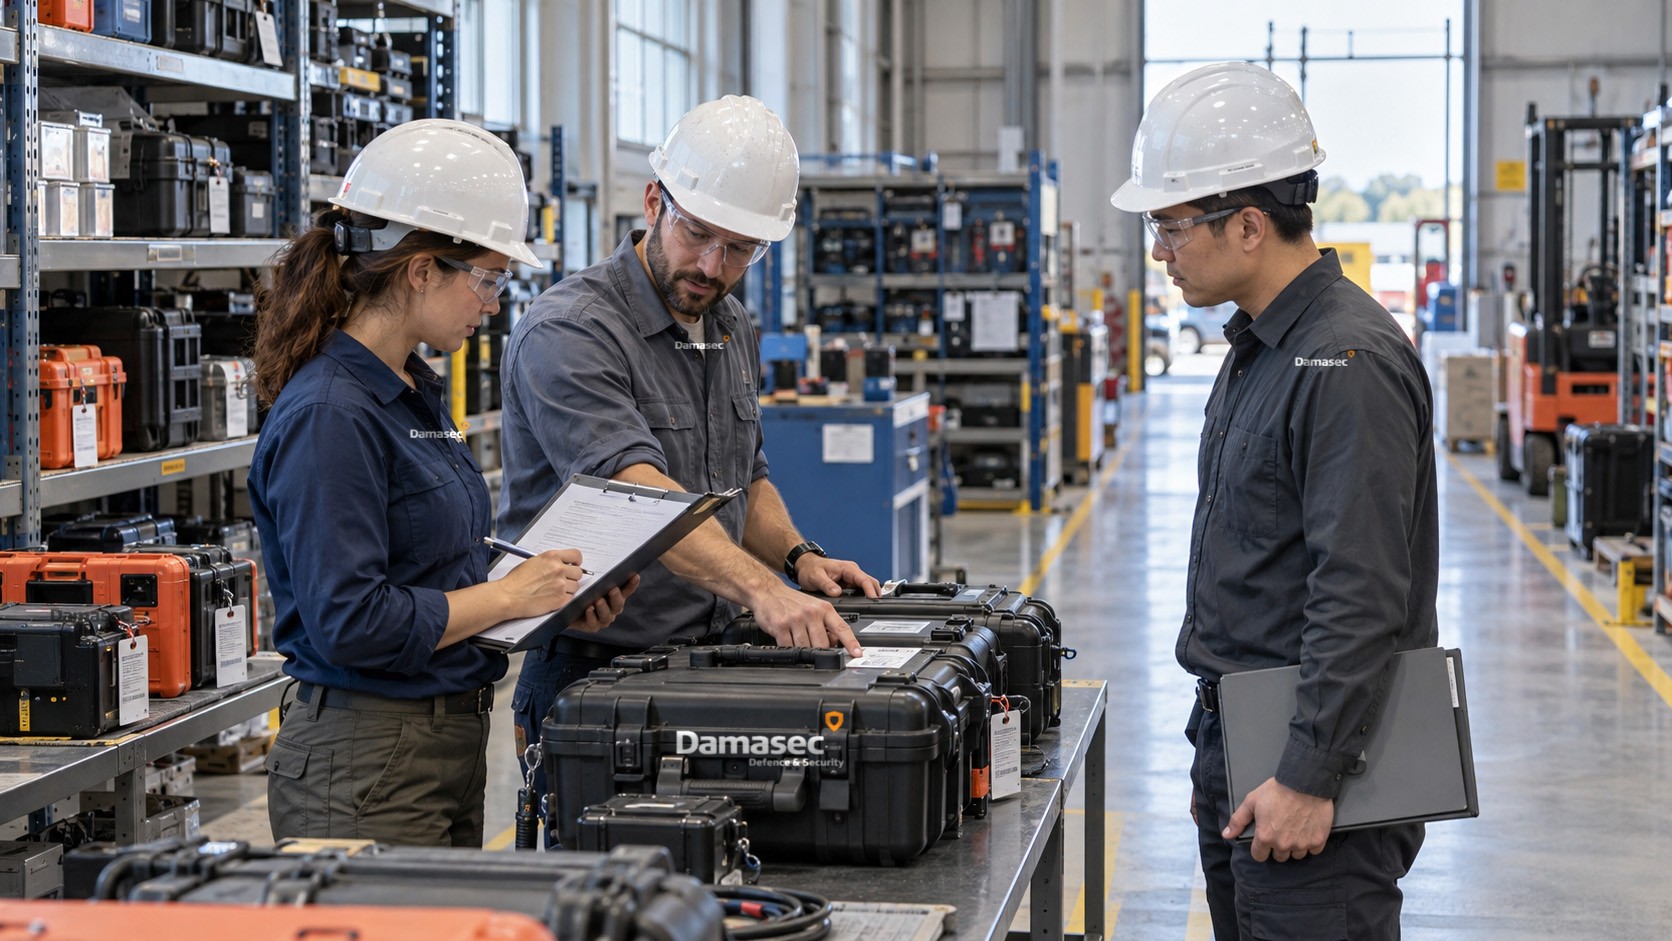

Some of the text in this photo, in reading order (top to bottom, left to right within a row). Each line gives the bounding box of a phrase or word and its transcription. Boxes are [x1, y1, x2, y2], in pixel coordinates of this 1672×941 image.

[674, 341, 724, 350] Damasec
[1294, 356, 1349, 367] Damasec
[409, 428, 463, 439] Damasec
[675, 730, 825, 755] Damasec
[749, 758, 844, 769] Defence & Security
